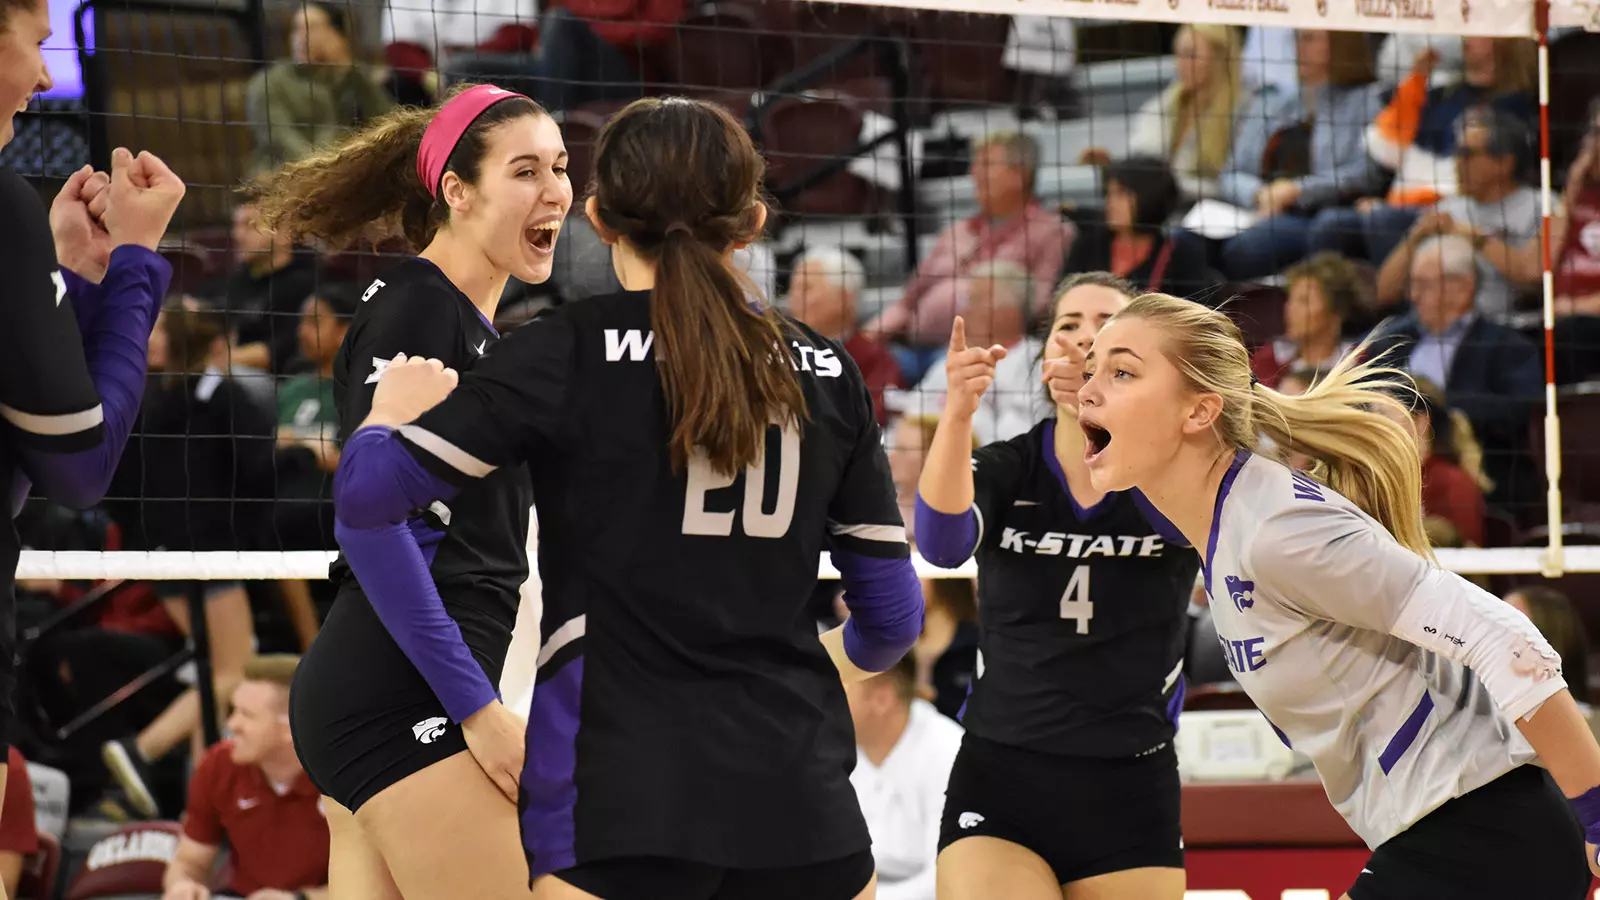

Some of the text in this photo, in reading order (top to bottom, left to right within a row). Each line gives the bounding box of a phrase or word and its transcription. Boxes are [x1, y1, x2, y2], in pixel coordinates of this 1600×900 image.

[1354, 0, 1435, 20] VOLLEYBALL
[682, 402, 802, 539] 20
[1000, 527, 1164, 558] K-STATE
[1060, 565, 1094, 635] 4
